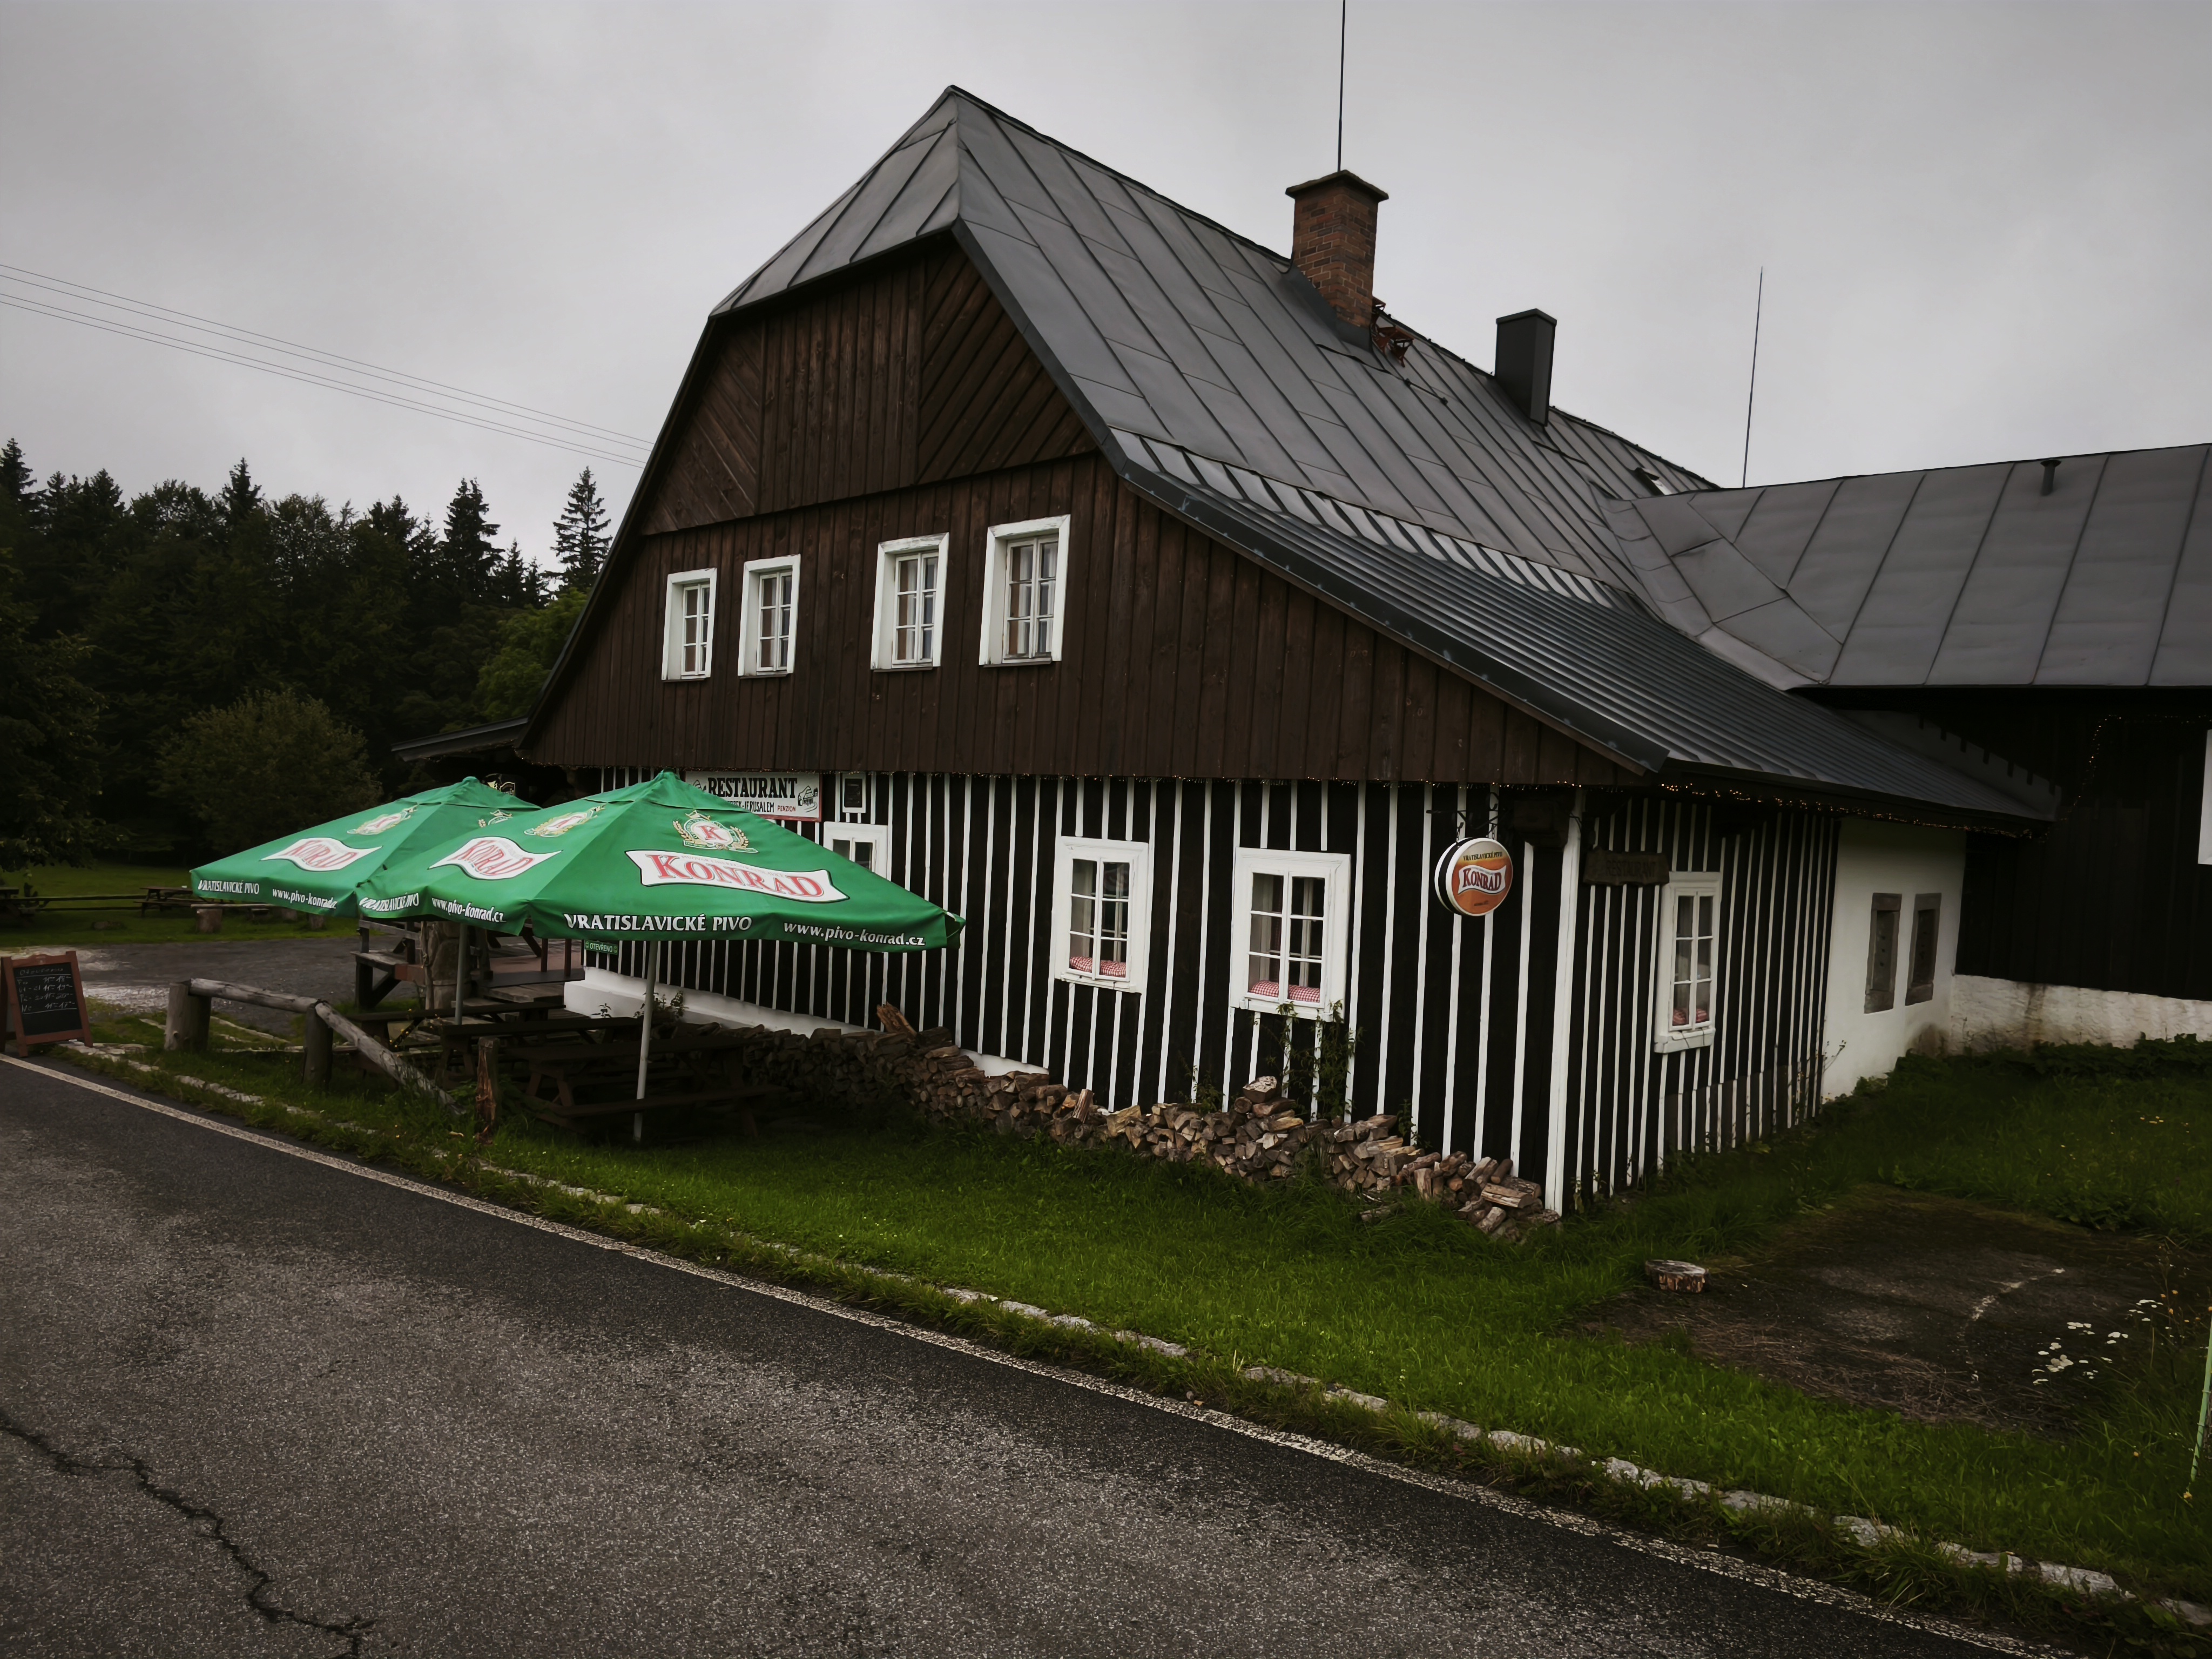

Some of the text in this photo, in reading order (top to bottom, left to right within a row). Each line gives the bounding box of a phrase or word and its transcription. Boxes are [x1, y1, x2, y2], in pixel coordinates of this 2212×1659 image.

[707, 777, 798, 799] RESTAURANT
[697, 825, 727, 841] K
[447, 840, 535, 876] KONRAD
[1463, 851, 1493, 861] VRATISLAVICKÉ
[198, 879, 260, 894] VRATISLAVICKÉ PIVO
[646, 854, 824, 898] KONRAD
[1462, 867, 1502, 891] KONRAD
[432, 899, 507, 922] www.pivo-konrad.cz
[563, 913, 752, 931] VRATISLAVICKÉ PIVO
[784, 922, 926, 946] www.pivo-konrad.cz
[590, 942, 613, 952] OTEVŘENO
